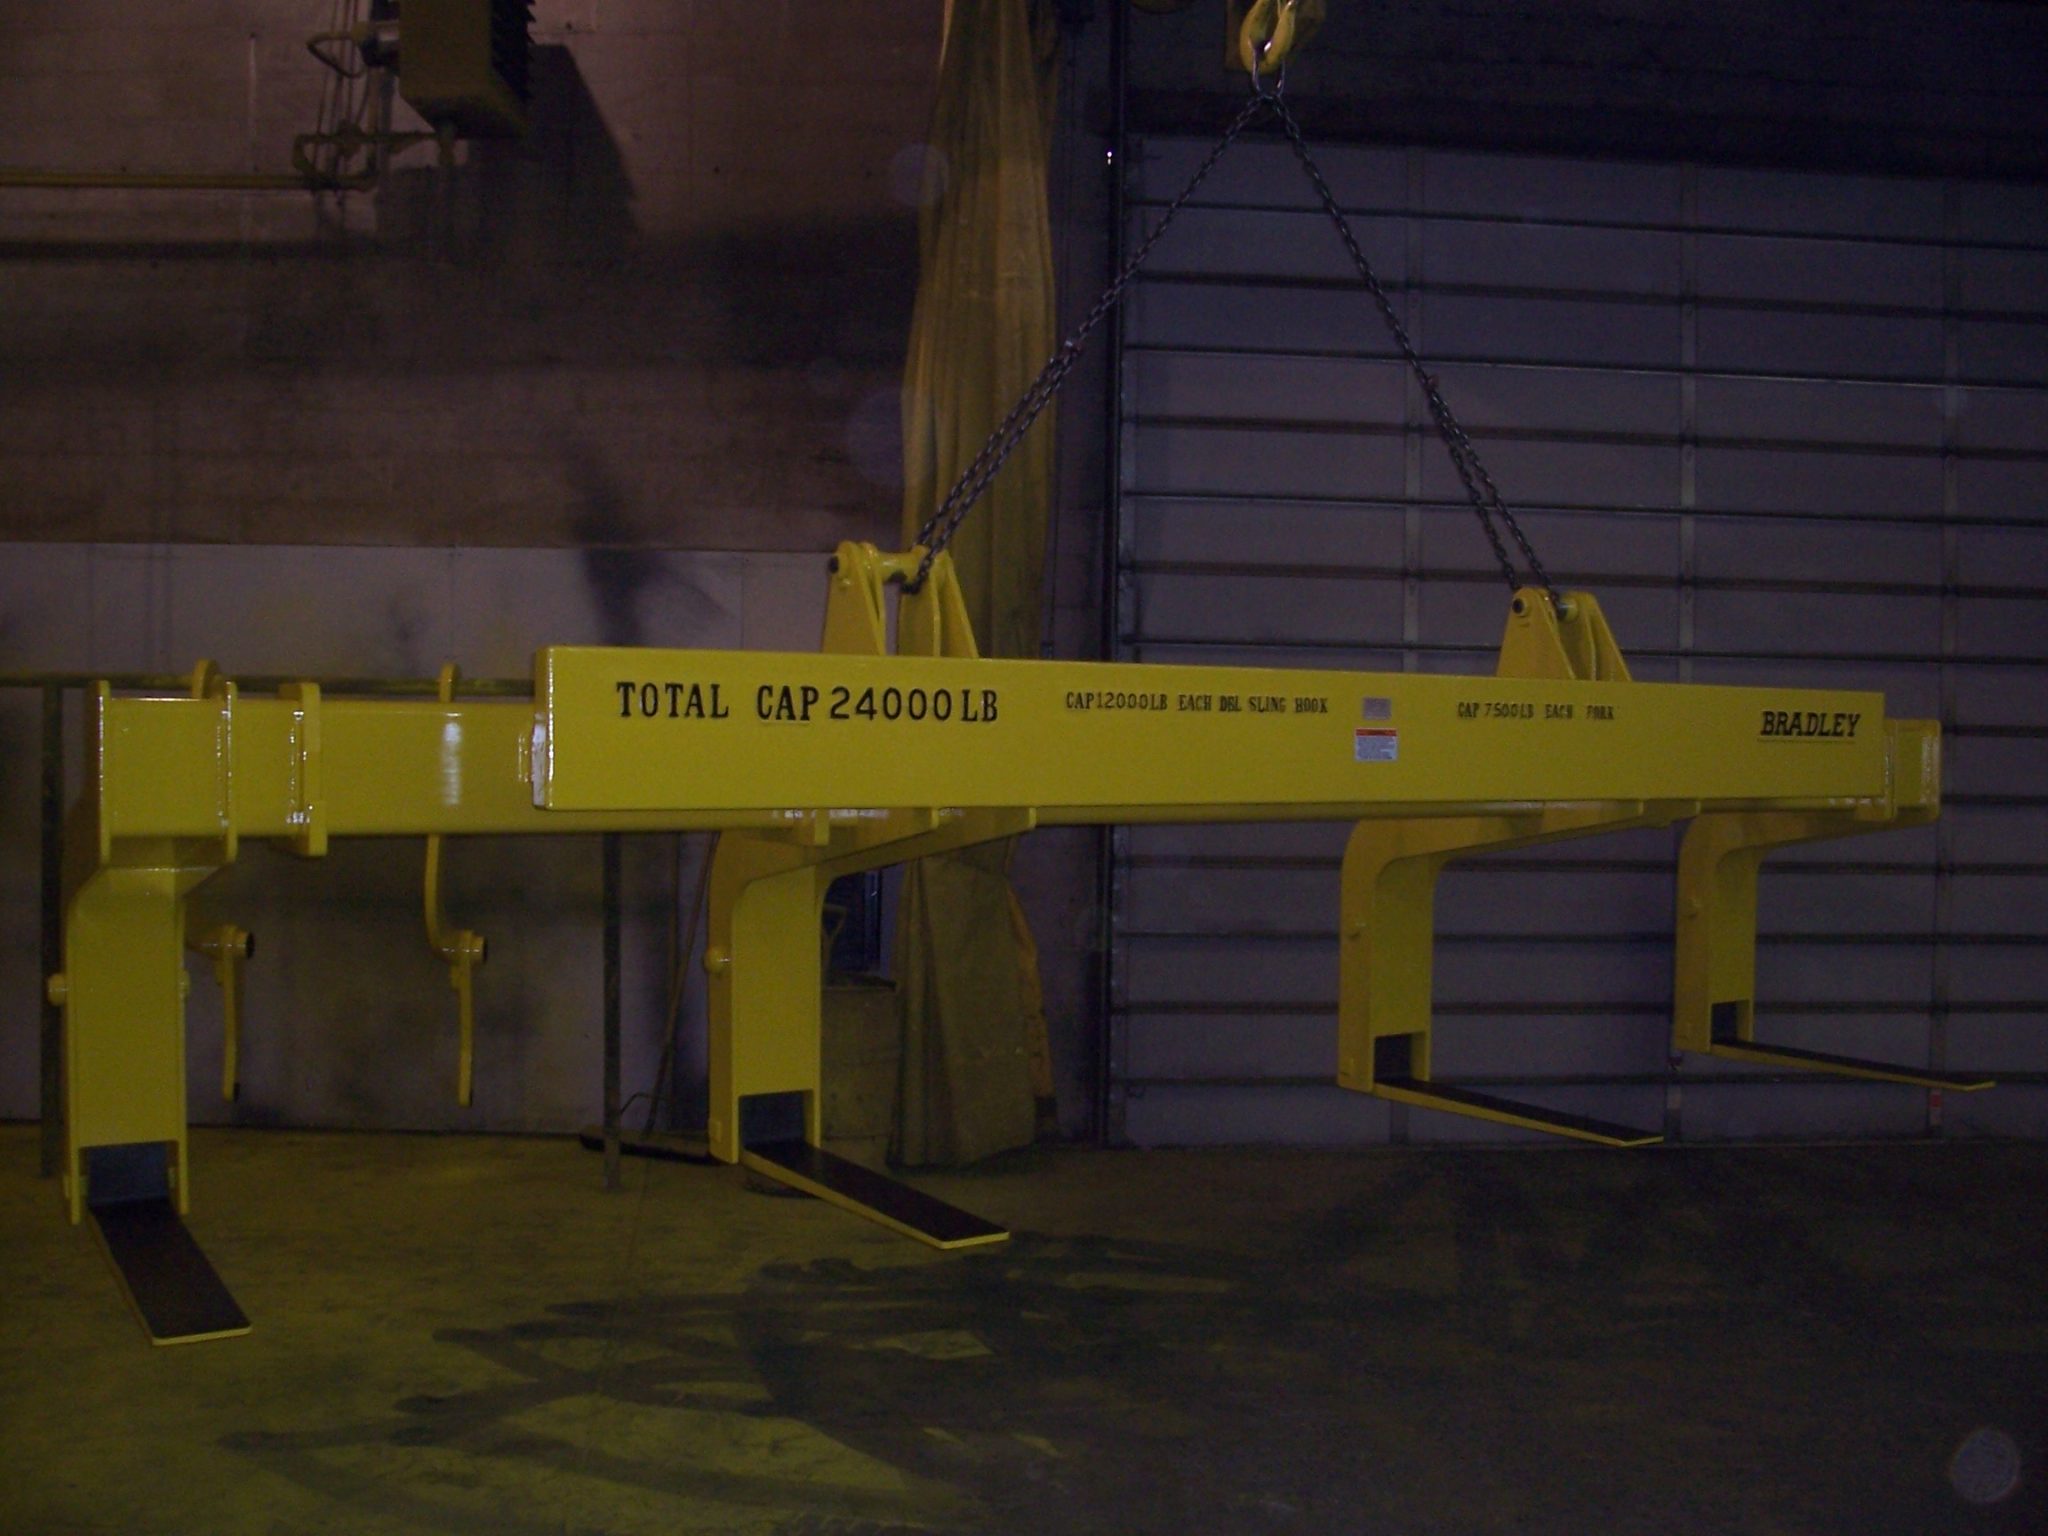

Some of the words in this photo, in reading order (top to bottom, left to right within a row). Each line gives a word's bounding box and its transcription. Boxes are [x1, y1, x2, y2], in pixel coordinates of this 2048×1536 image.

[616, 681, 729, 719] TOTAL
[1178, 694, 1212, 712] EACH
[1250, 695, 1287, 713] SLING
[1458, 701, 1479, 718] CAP
[1544, 703, 1573, 720] EACH
[1760, 710, 1861, 737] BRADLEY
